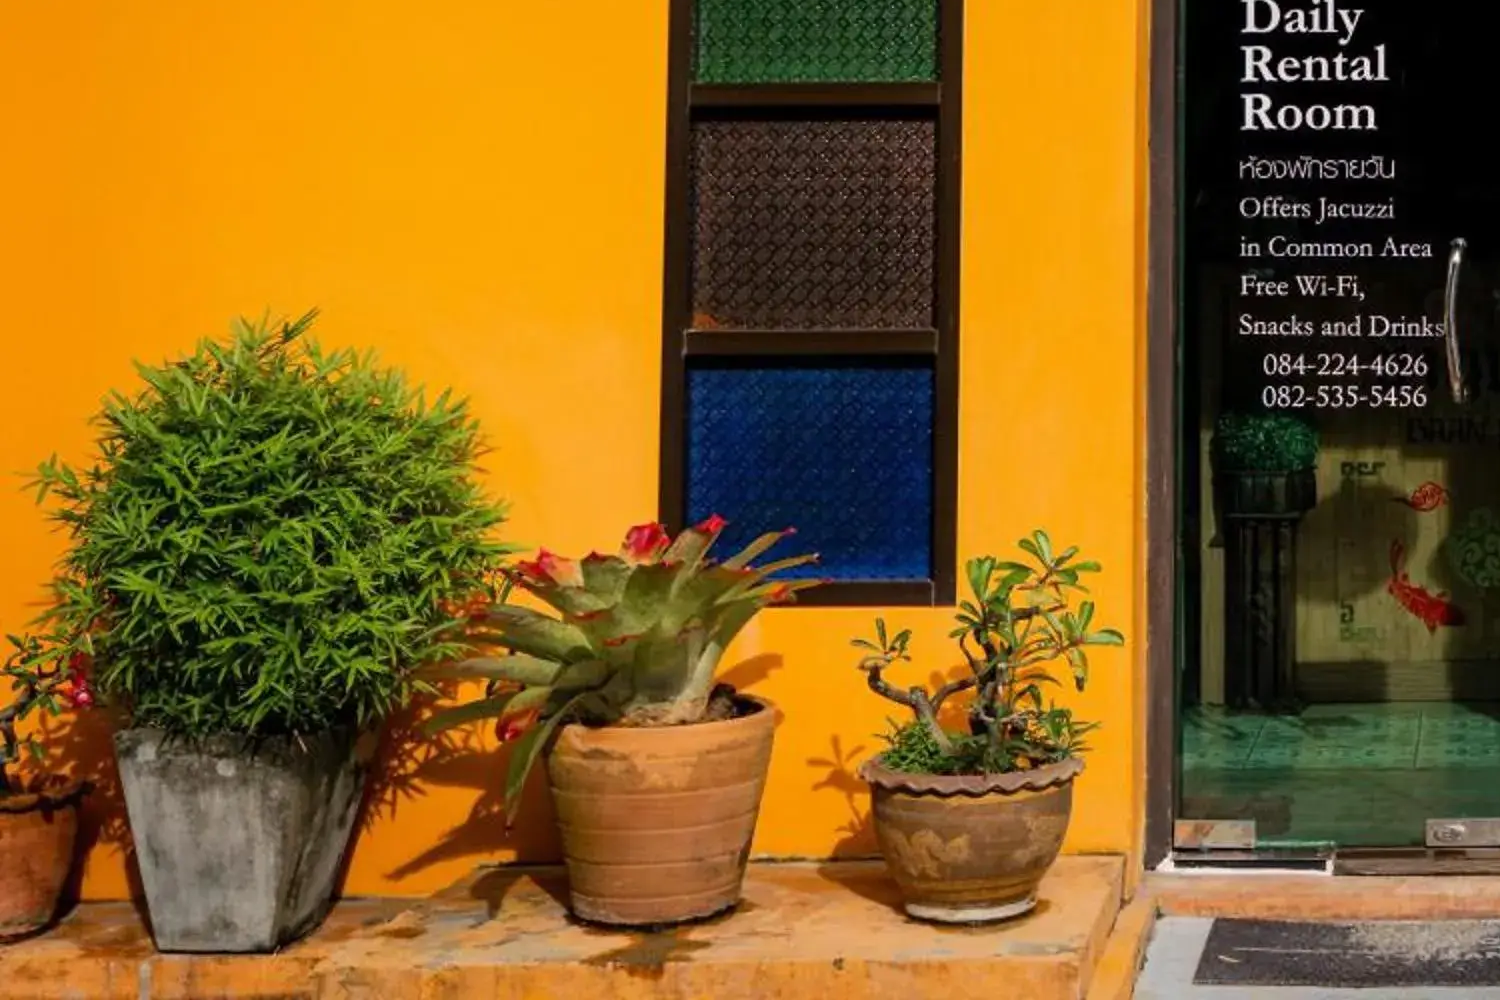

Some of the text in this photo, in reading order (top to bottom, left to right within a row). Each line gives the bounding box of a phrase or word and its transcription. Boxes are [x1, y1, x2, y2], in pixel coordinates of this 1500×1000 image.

[1240, 42, 1390, 83] Rental
[1240, 93, 1378, 131] Room
[1239, 155, 1395, 179] ห้องพักรายวัน
[1239, 196, 1394, 225] Offers Jacuzzi
[1240, 235, 1433, 257] in Common Area
[1240, 274, 1365, 301] Free Wi-Fi,
[1239, 313, 1445, 337] Snacks and Drinks
[1263, 353, 1428, 377] 084-224-4626
[1262, 385, 1428, 409] 082-535-5456
